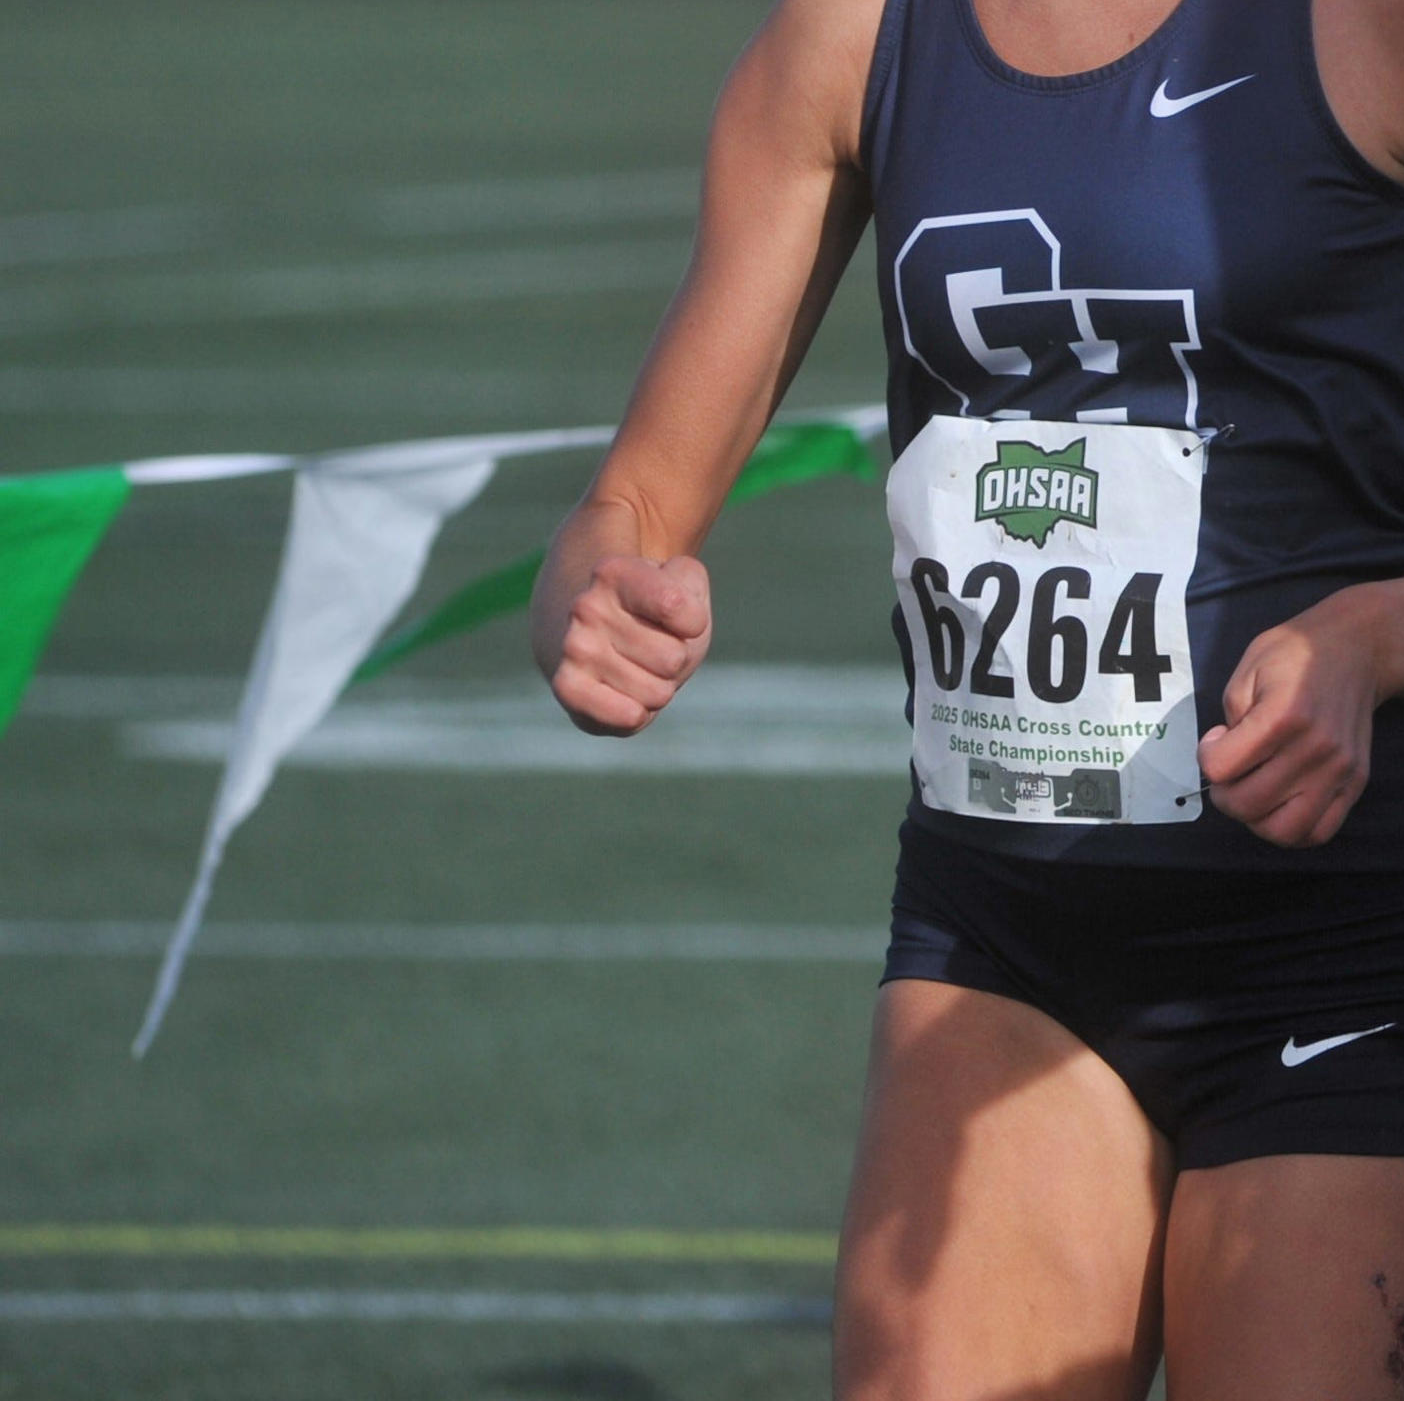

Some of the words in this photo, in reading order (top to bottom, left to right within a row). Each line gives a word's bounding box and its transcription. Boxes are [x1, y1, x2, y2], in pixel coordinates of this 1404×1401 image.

[982, 469, 1094, 519] OHSAA
[911, 556, 1173, 704] 6264
[931, 703, 958, 725] 2025
[962, 710, 1012, 732] OHSAA
[1017, 716, 1072, 736] Cross
[1079, 719, 1169, 740] Country
[949, 733, 984, 755] State
[988, 740, 1125, 767] Championship
